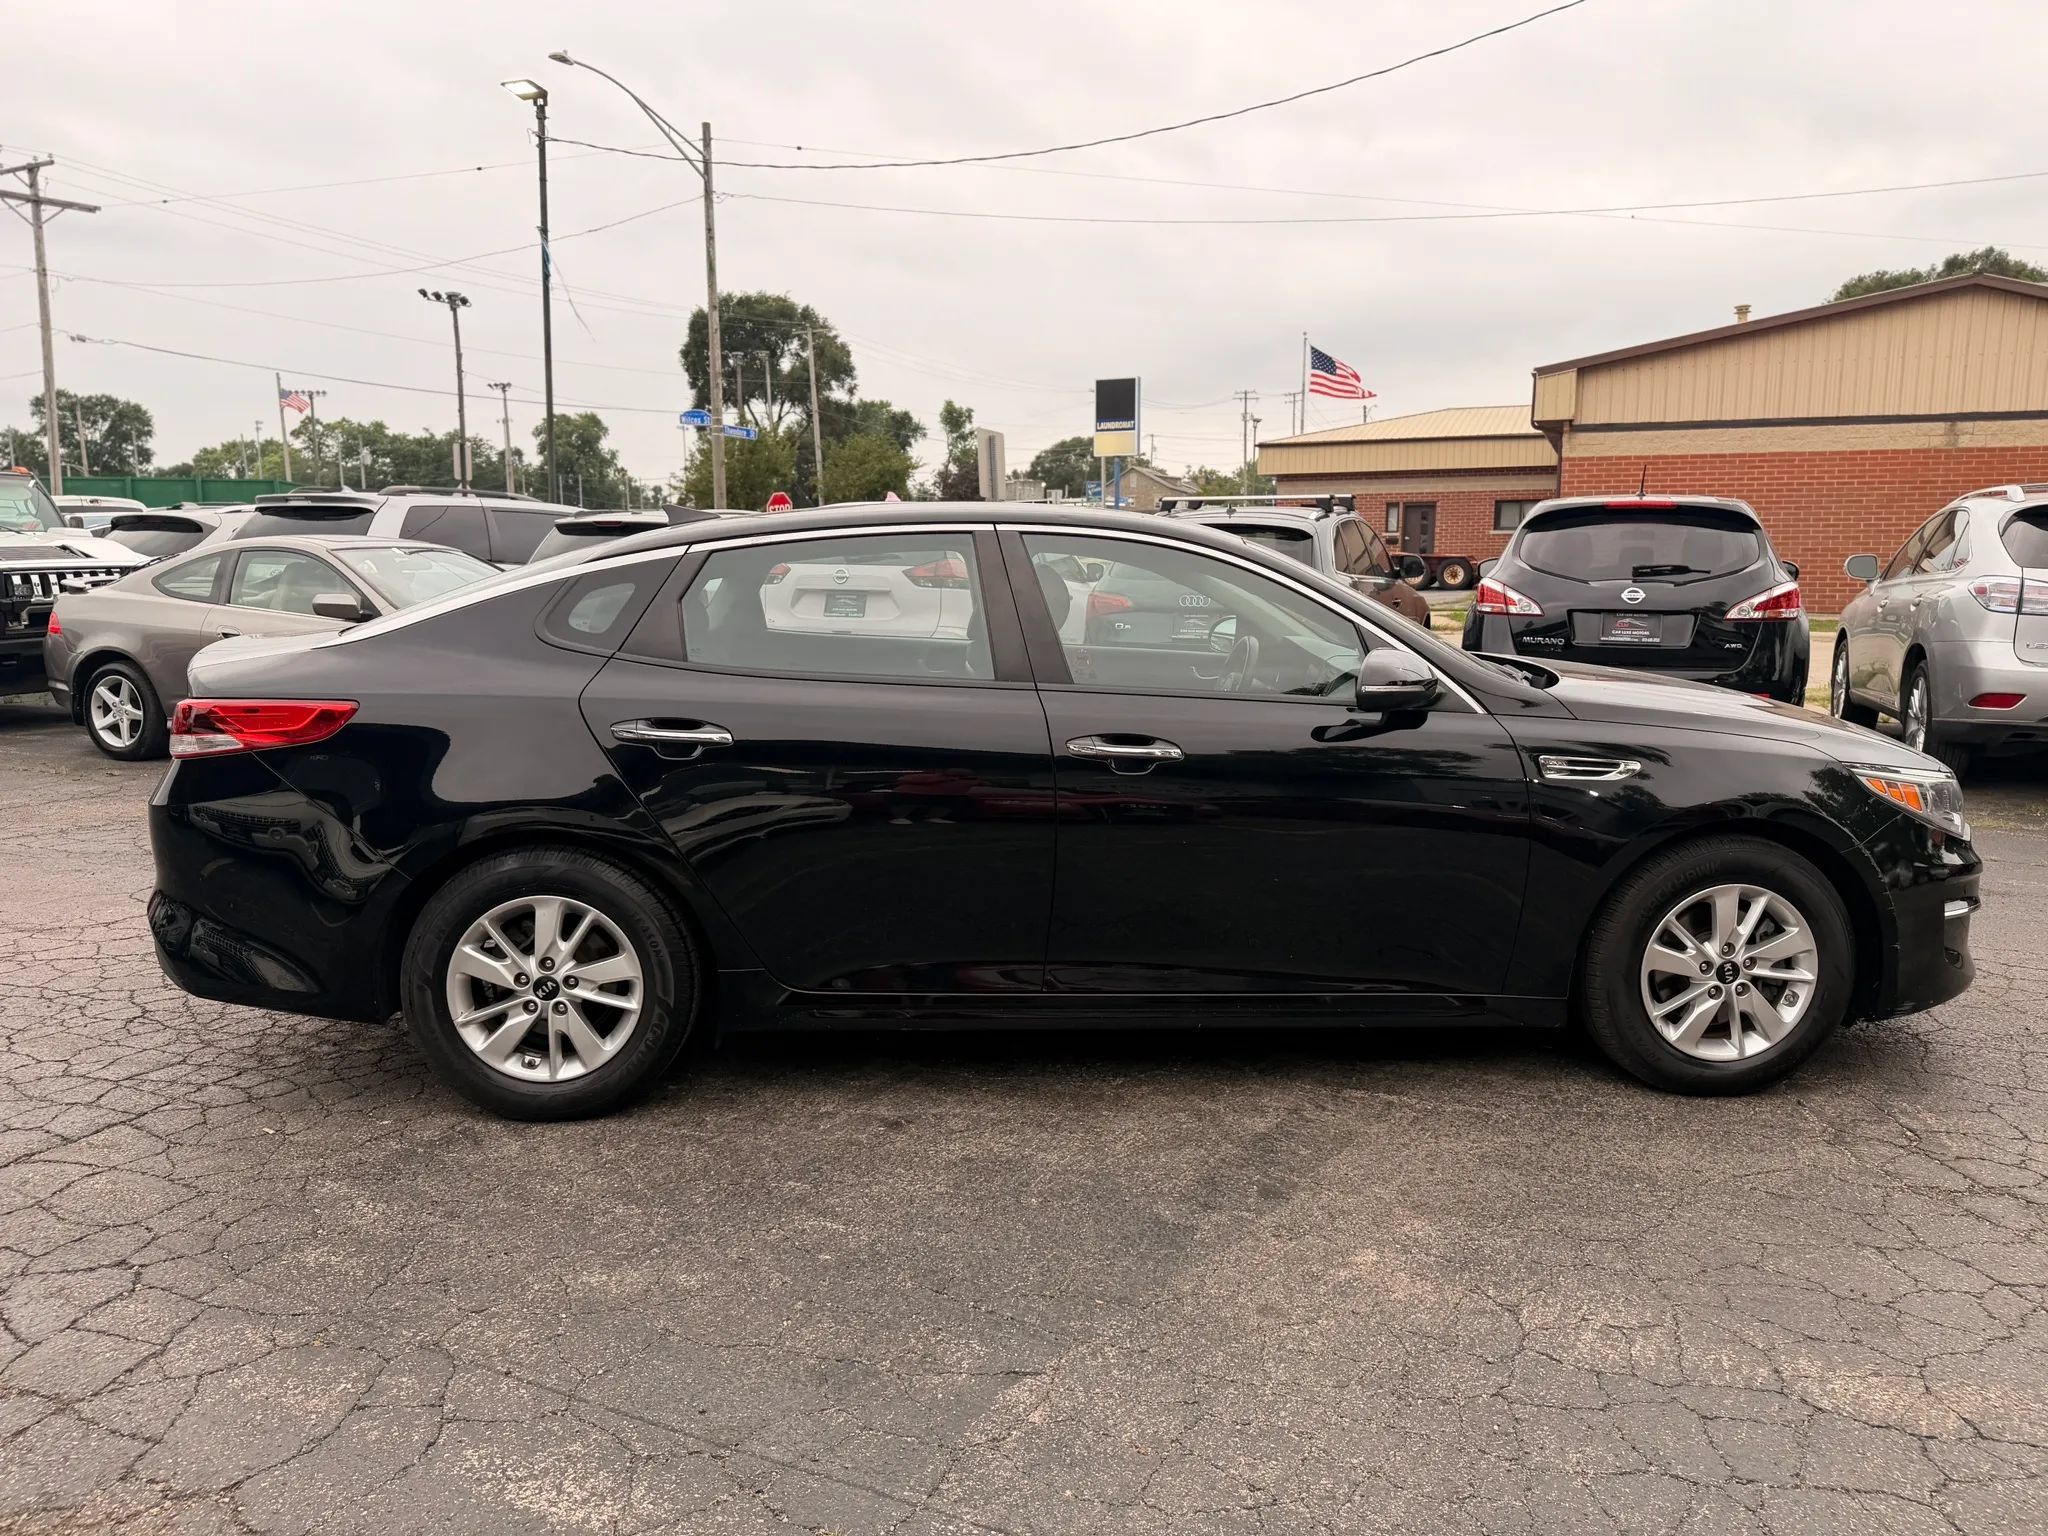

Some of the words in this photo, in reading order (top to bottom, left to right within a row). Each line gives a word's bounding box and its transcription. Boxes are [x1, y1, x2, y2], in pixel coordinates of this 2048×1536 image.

[703, 415, 711, 425] St
[1097, 421, 1135, 430] LAUNDROMAT
[769, 504, 790, 512] STOP
[1522, 636, 1565, 645] MURANO
[1723, 962, 1733, 983] KIA
[535, 981, 556, 998] KIA
